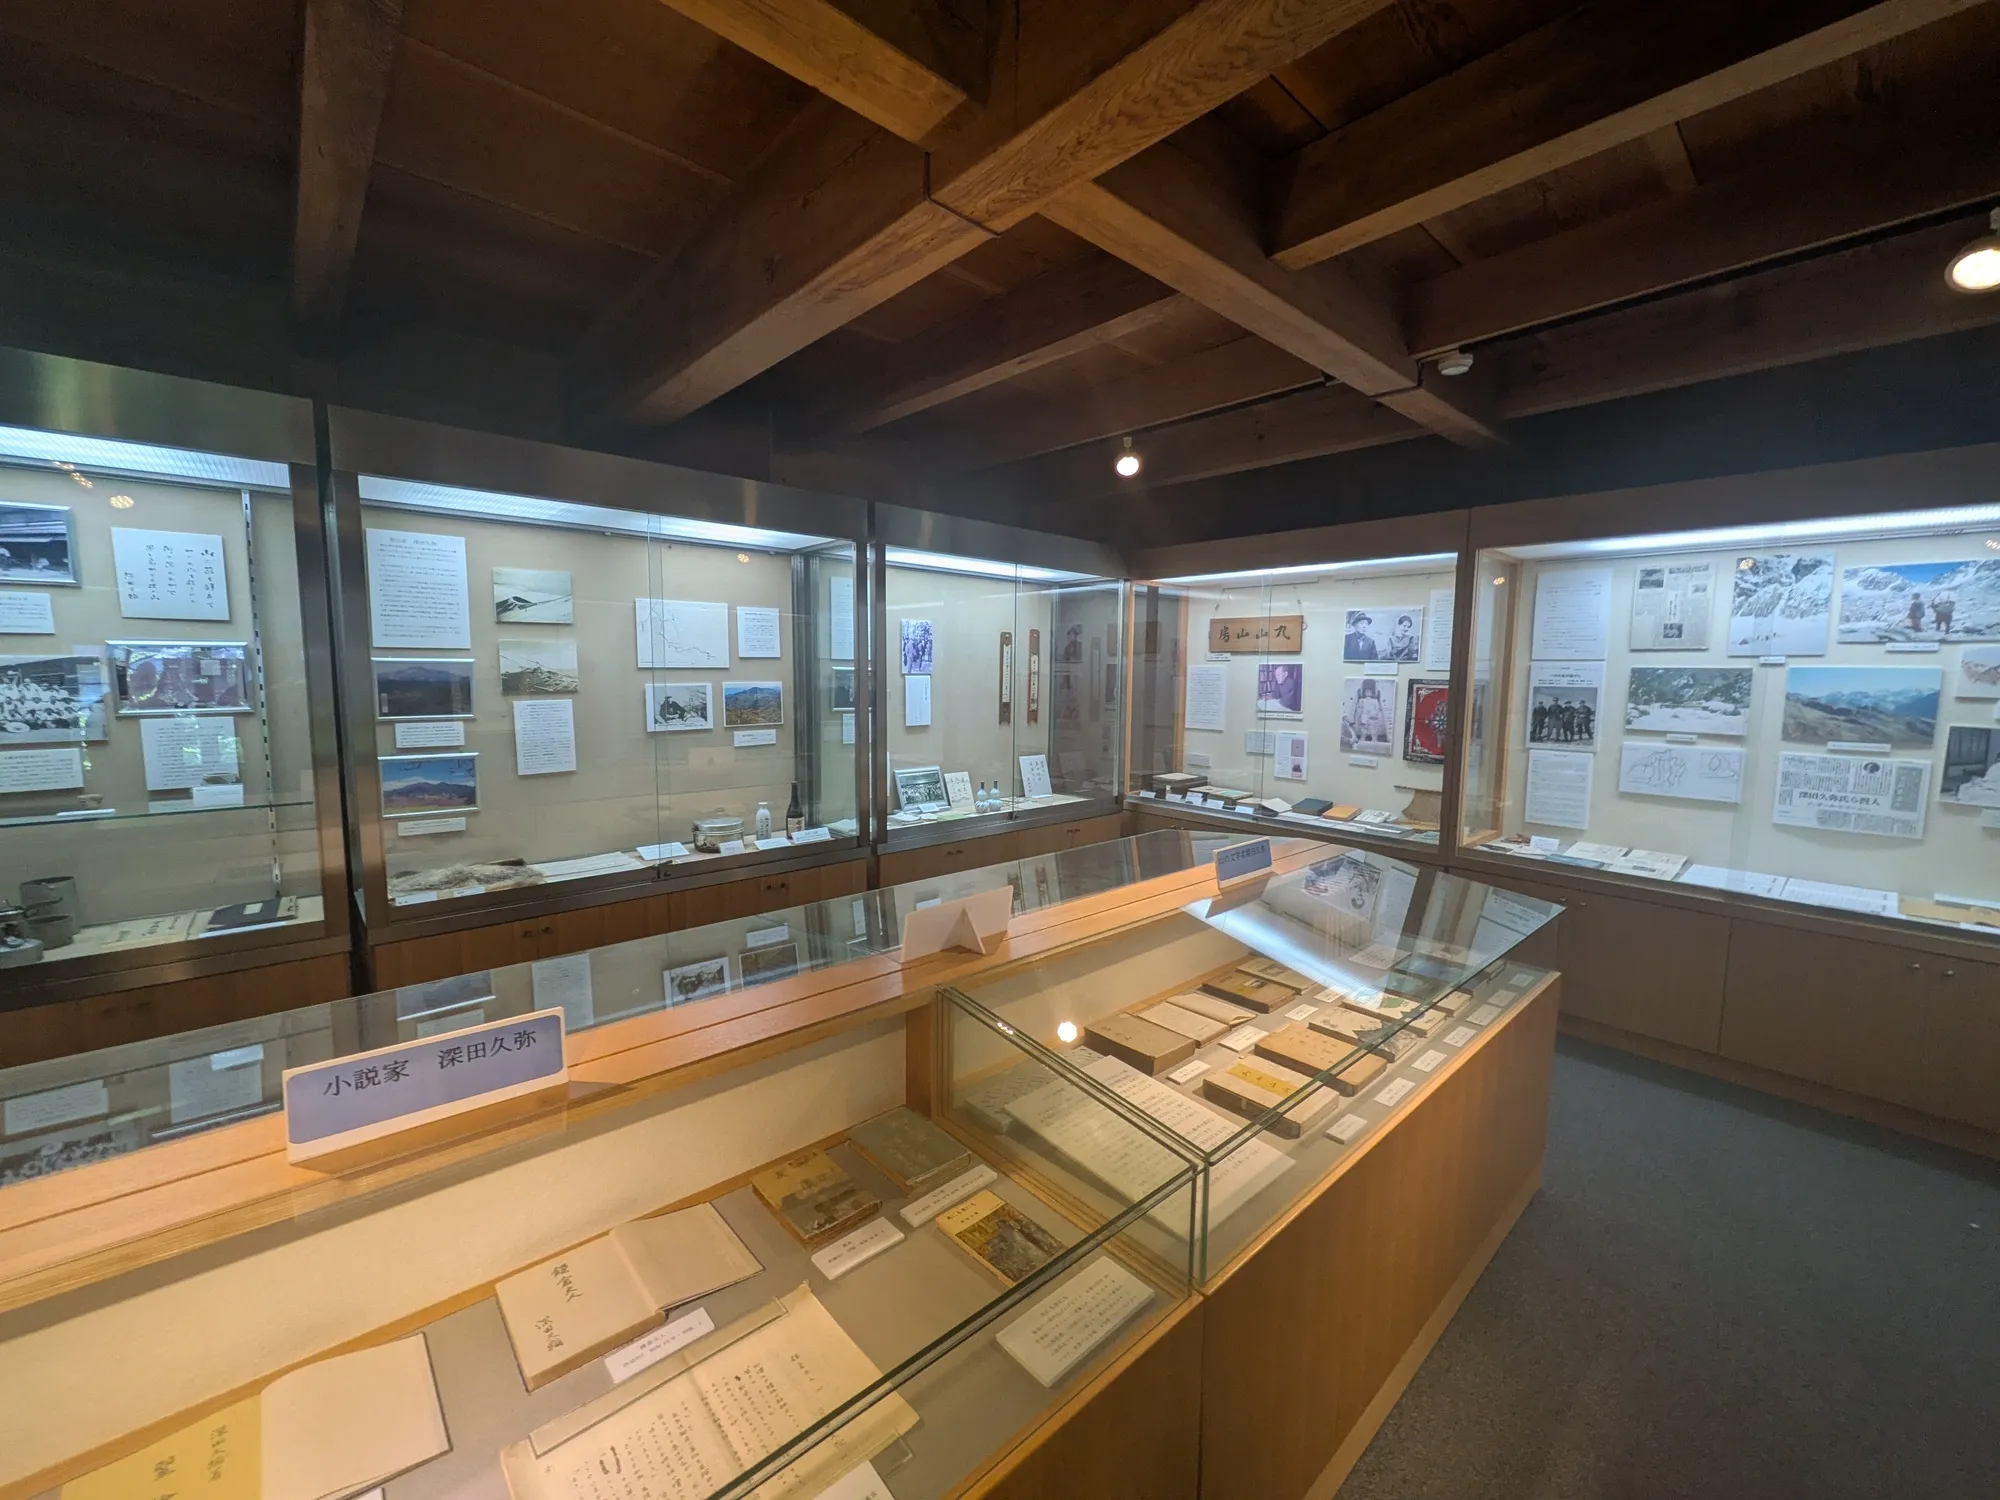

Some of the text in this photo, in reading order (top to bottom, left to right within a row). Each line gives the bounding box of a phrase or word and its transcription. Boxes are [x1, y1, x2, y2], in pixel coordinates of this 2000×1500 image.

[322, 1028, 538, 1097] 小説家 深田久弥
